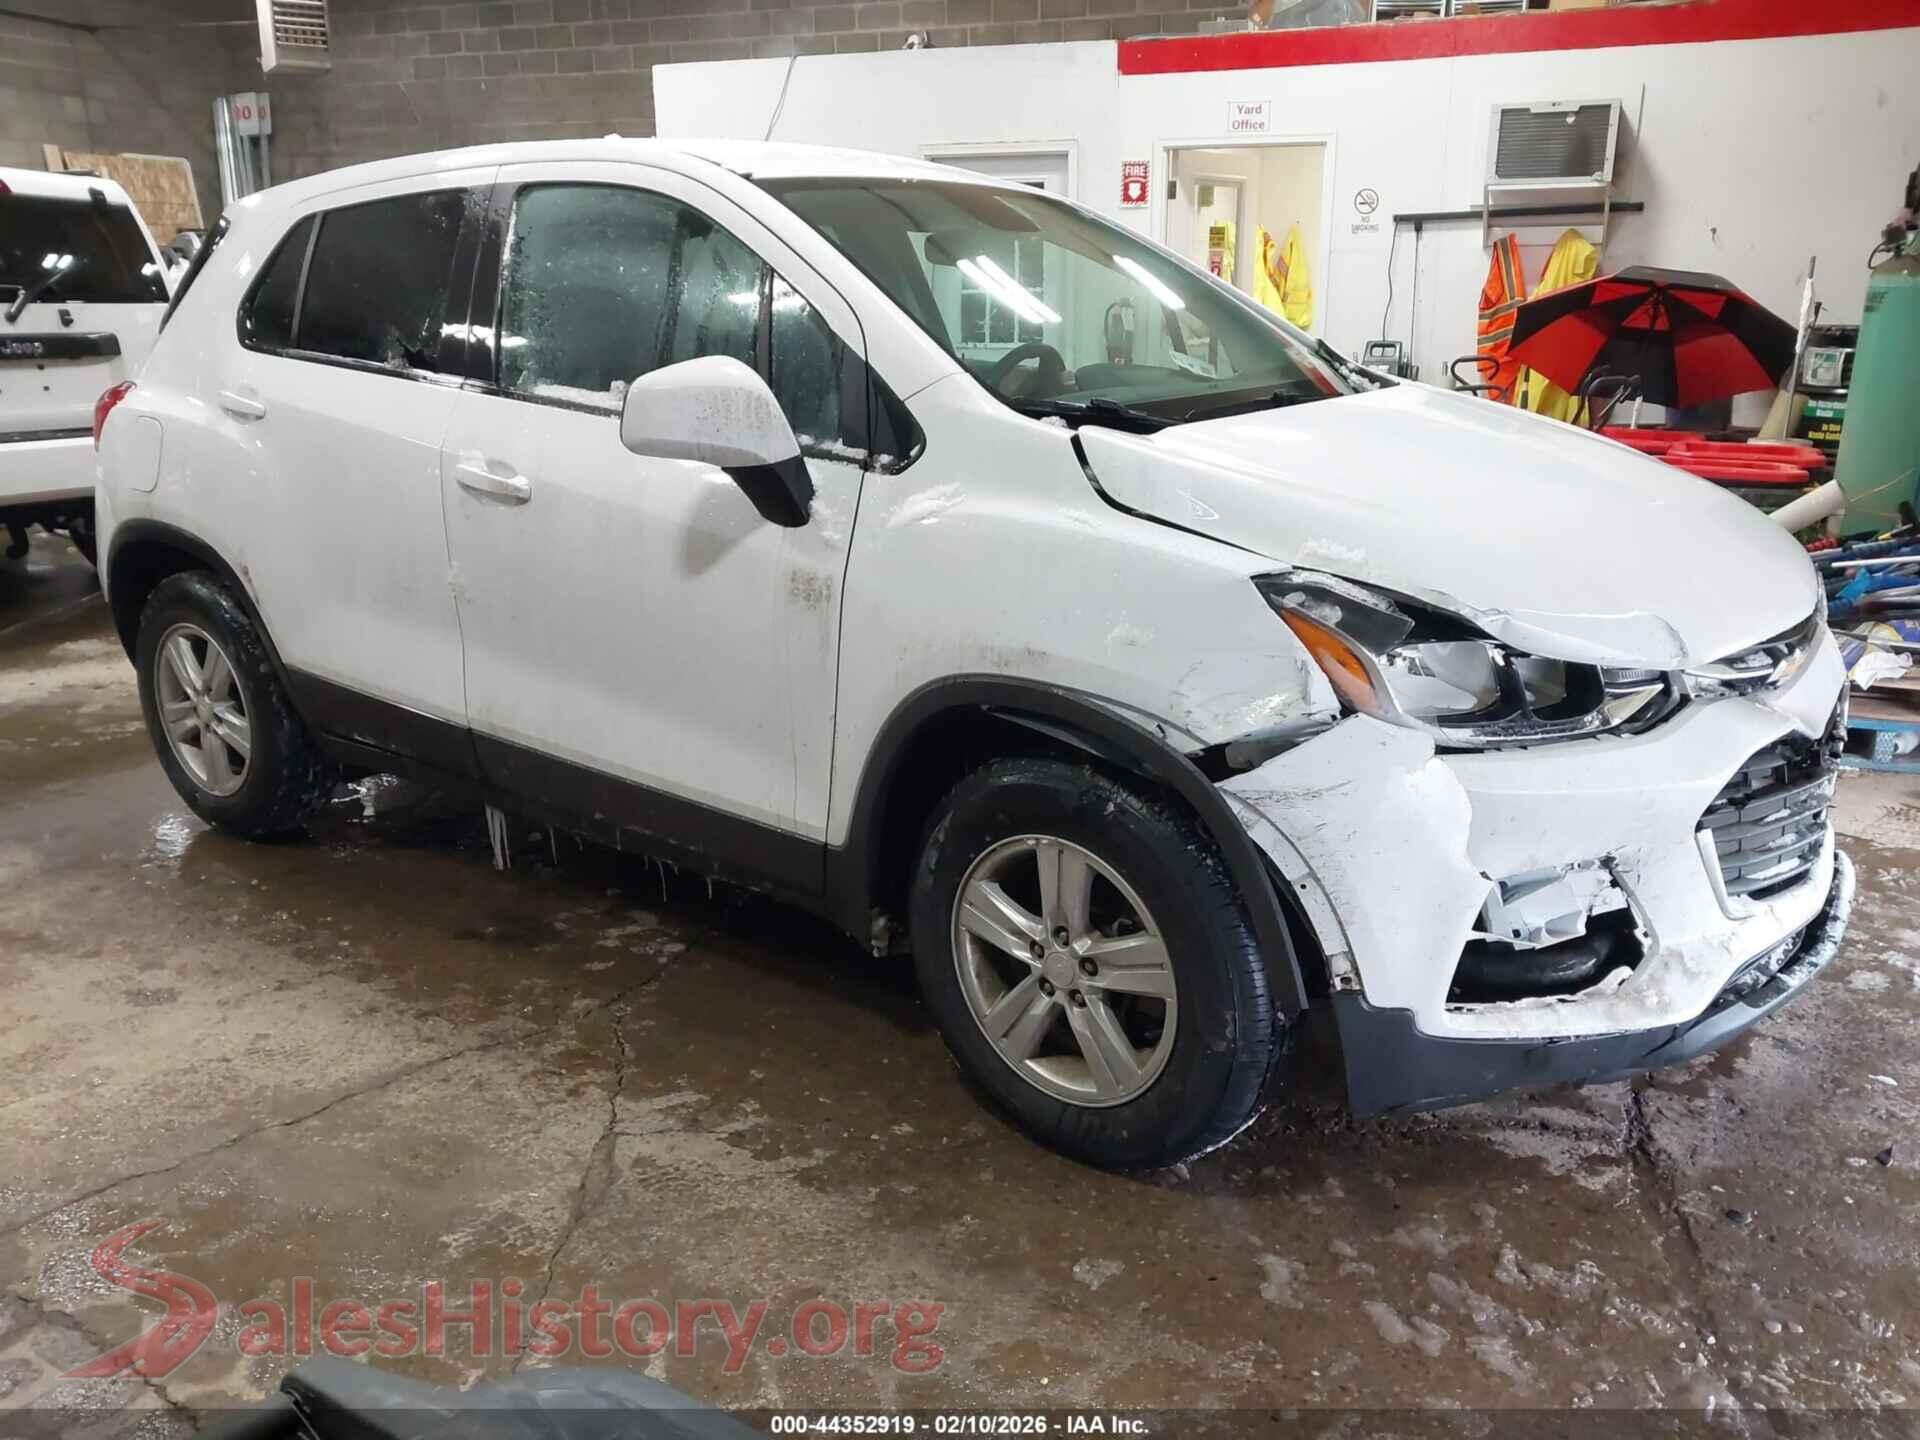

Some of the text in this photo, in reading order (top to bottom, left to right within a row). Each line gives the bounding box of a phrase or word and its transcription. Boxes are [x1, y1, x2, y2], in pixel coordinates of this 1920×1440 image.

[1236, 103, 1262, 115] Yard
[1232, 119, 1265, 130] Office
[1125, 165, 1147, 176] FIRE
[1, 340, 43, 357] Jeep
